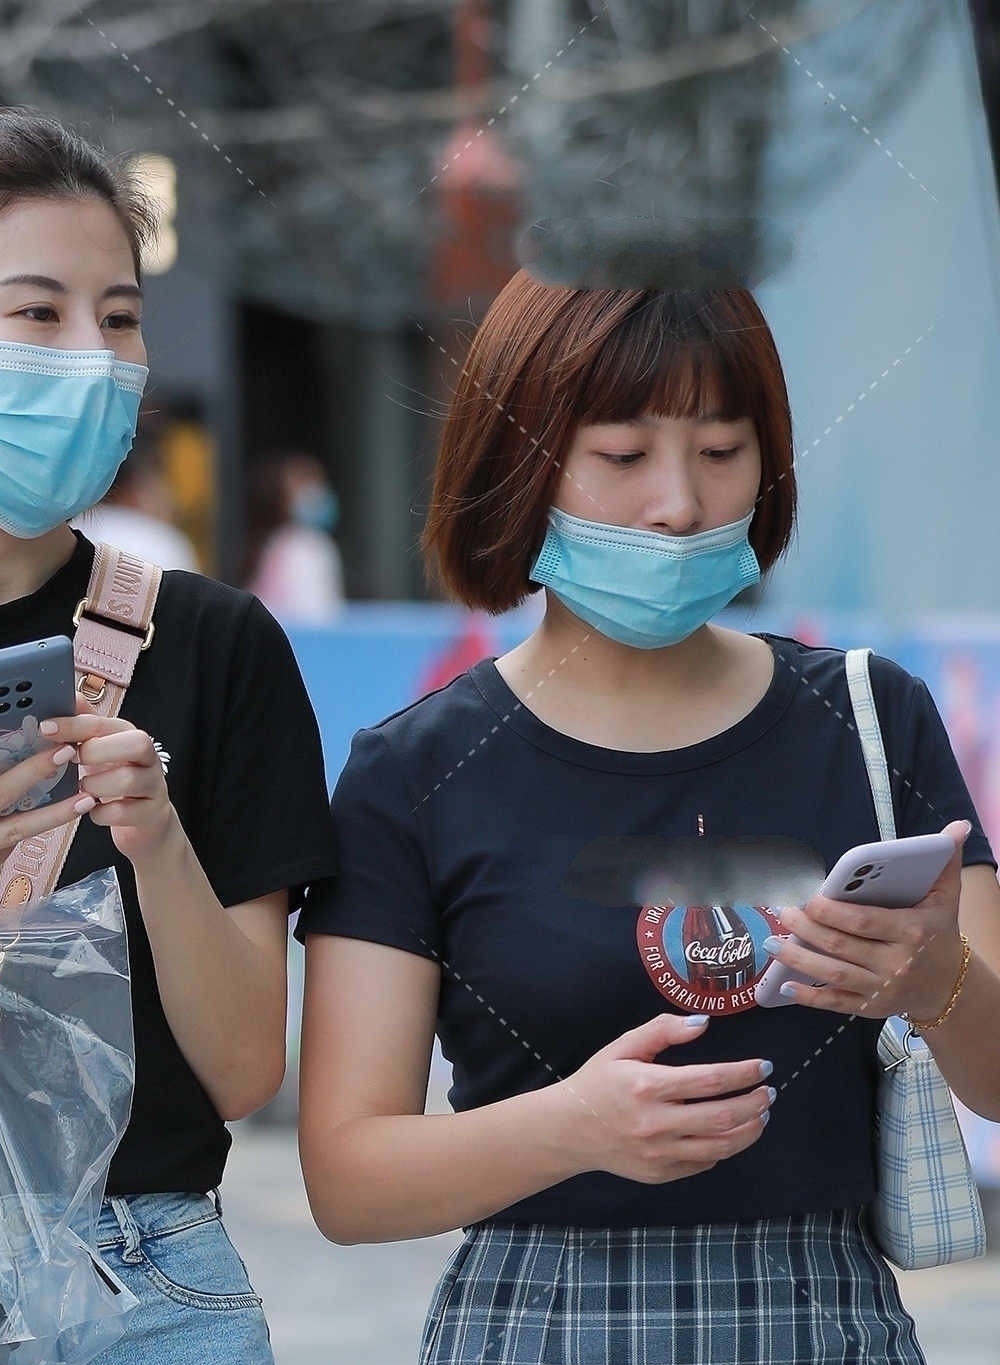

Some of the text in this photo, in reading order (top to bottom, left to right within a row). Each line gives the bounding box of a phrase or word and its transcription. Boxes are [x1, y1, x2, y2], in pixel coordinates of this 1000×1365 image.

[684, 932, 753, 965] Coca-Cola
[643, 945, 759, 1011] FOR SPARKLING REF
